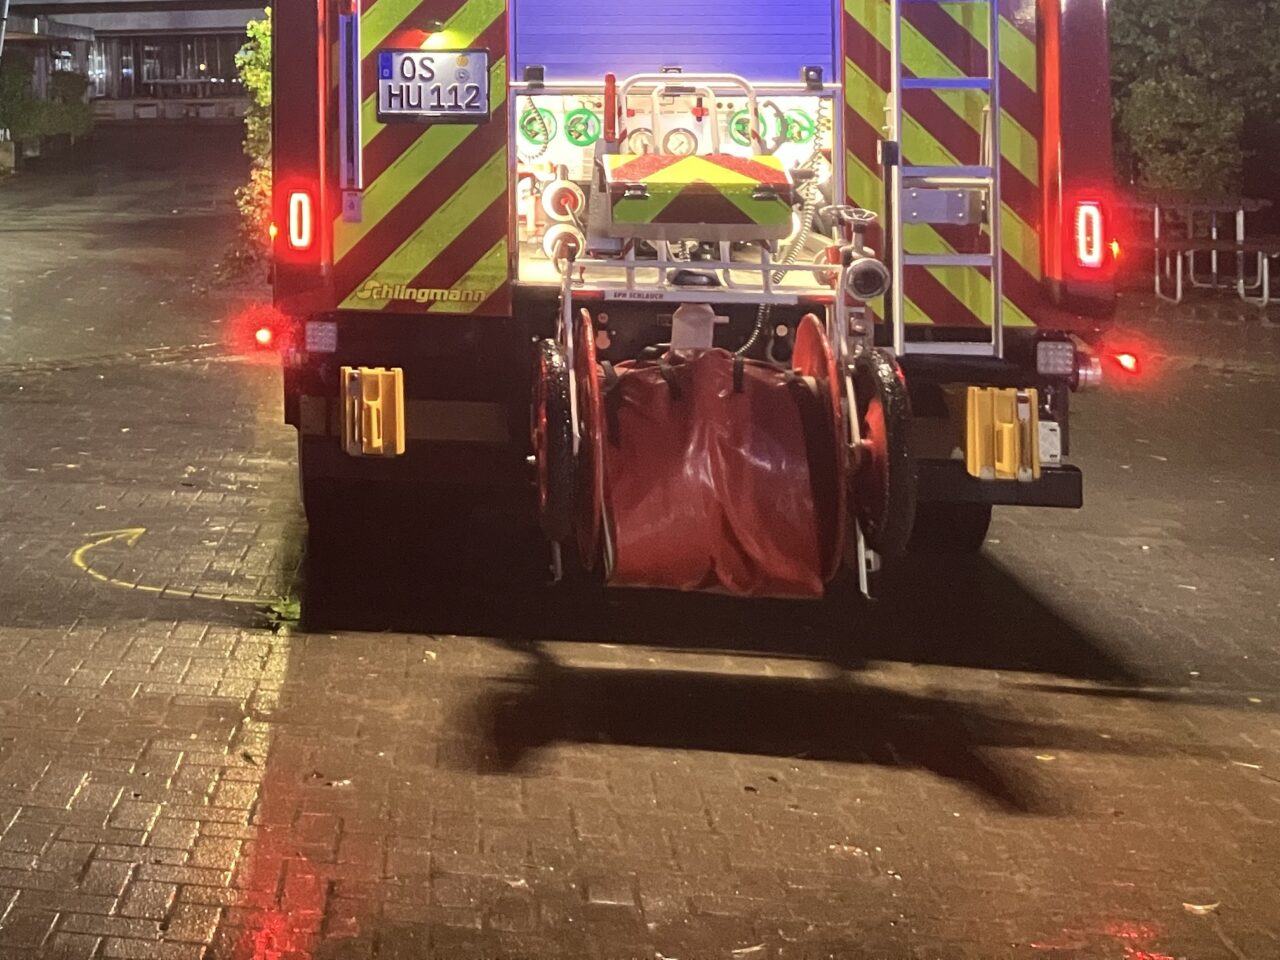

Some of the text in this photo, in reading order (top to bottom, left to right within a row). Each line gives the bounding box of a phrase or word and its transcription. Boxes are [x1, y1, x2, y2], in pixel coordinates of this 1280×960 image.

[400, 56, 435, 82] OS
[388, 84, 480, 109] HU 112
[355, 280, 488, 303] Schlingmann
